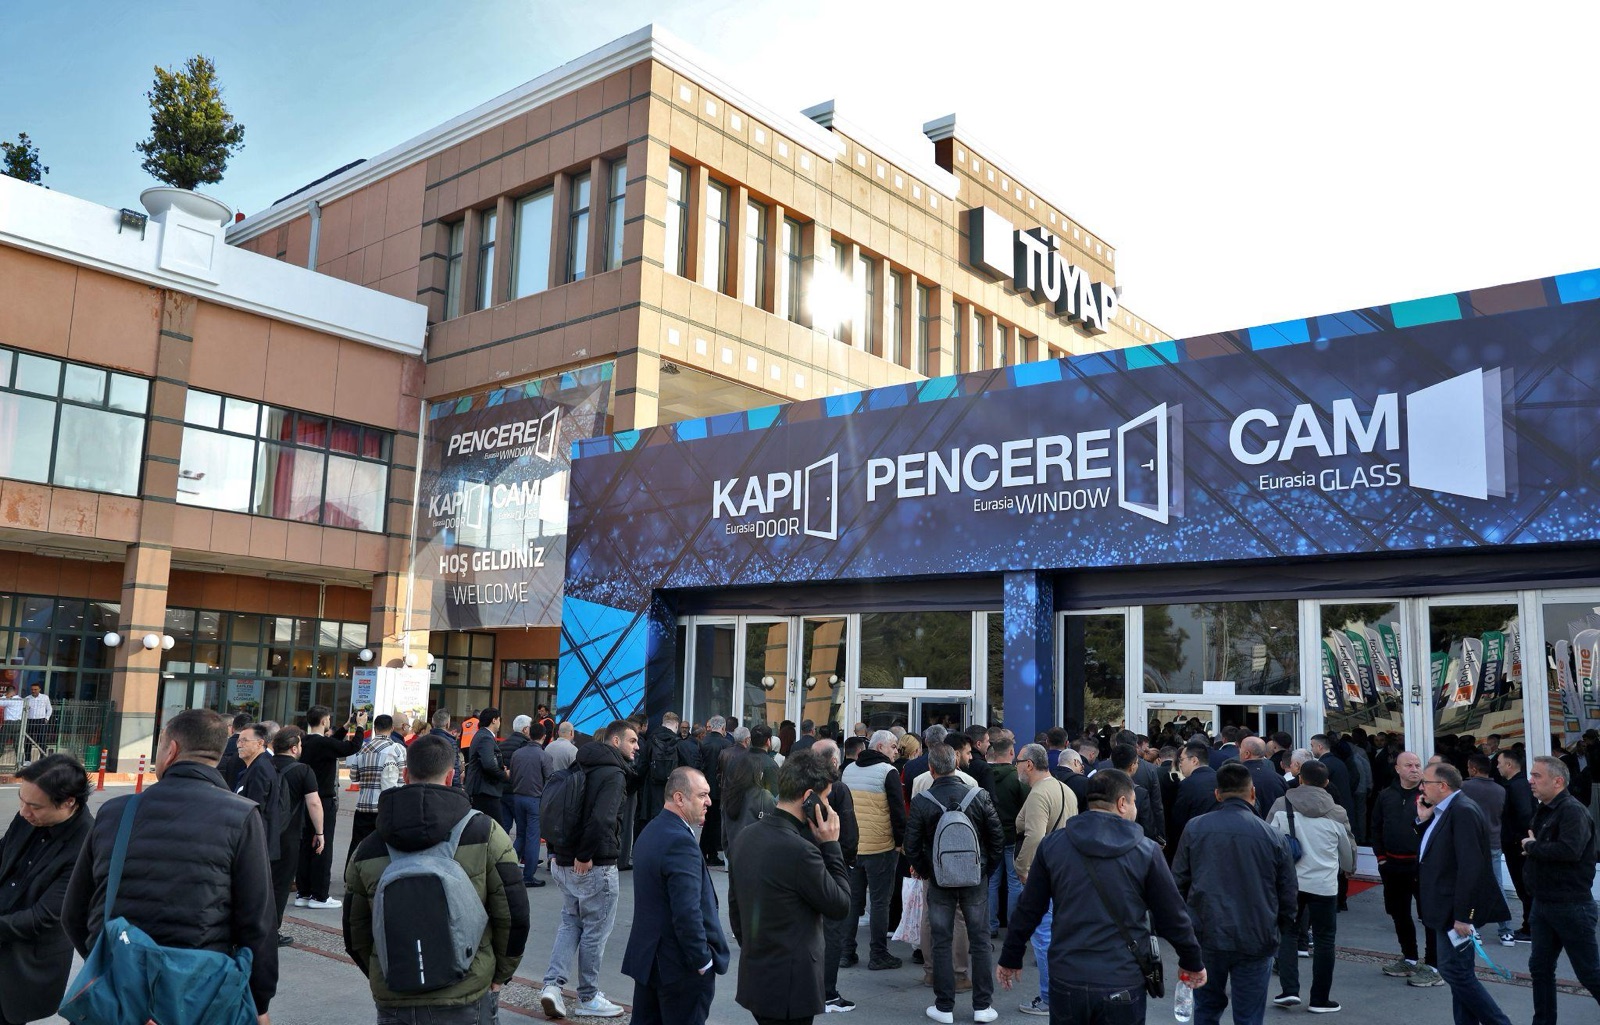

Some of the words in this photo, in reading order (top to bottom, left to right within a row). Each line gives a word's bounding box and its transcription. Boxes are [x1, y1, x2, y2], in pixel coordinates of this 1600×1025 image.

[1016, 227, 1118, 333] TÜYAP
[447, 419, 539, 456] PENCERE
[1229, 392, 1400, 465] CAM
[484, 451, 500, 460] Eurasia
[499, 444, 536, 460] WINDOW
[866, 428, 1112, 502] PENCERE
[1259, 471, 1316, 490] Eurasia
[1319, 463, 1402, 491] GLASS
[428, 489, 470, 518] KAPI
[492, 479, 541, 509] CAM
[712, 469, 802, 519] KAPI
[974, 496, 1014, 512] Eurasia
[1015, 486, 1111, 514] WINDOW
[445, 516, 466, 529] DOOR
[725, 522, 755, 535] Eurasia
[755, 517, 800, 538] DOOR
[439, 552, 468, 577] HOŞ
[472, 542, 545, 572] GELDİNİZ
[452, 581, 529, 606] WELCOME
[1579, 648, 1596, 702] proline
